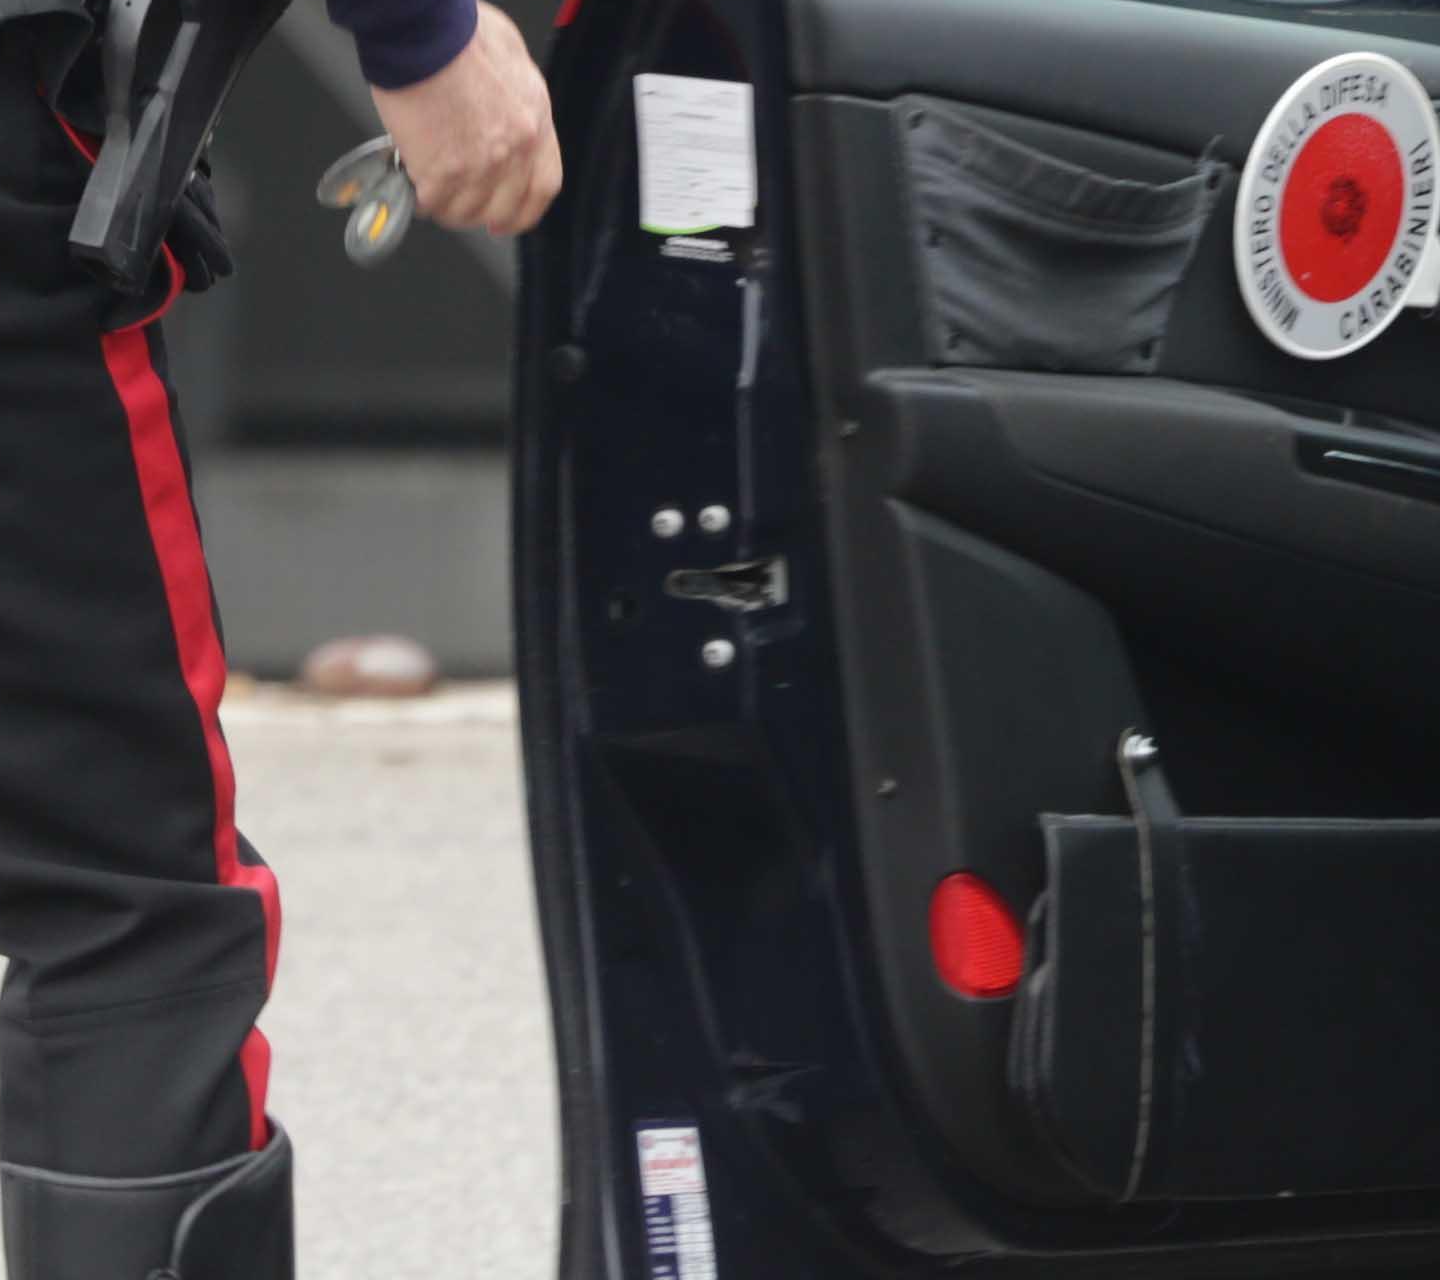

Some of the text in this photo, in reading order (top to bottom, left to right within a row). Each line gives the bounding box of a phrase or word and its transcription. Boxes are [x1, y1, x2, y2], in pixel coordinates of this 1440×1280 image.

[1250, 71, 1390, 332] MINISTERO DELLA DIFESA
[1338, 138, 1435, 341] CARABINIERI
